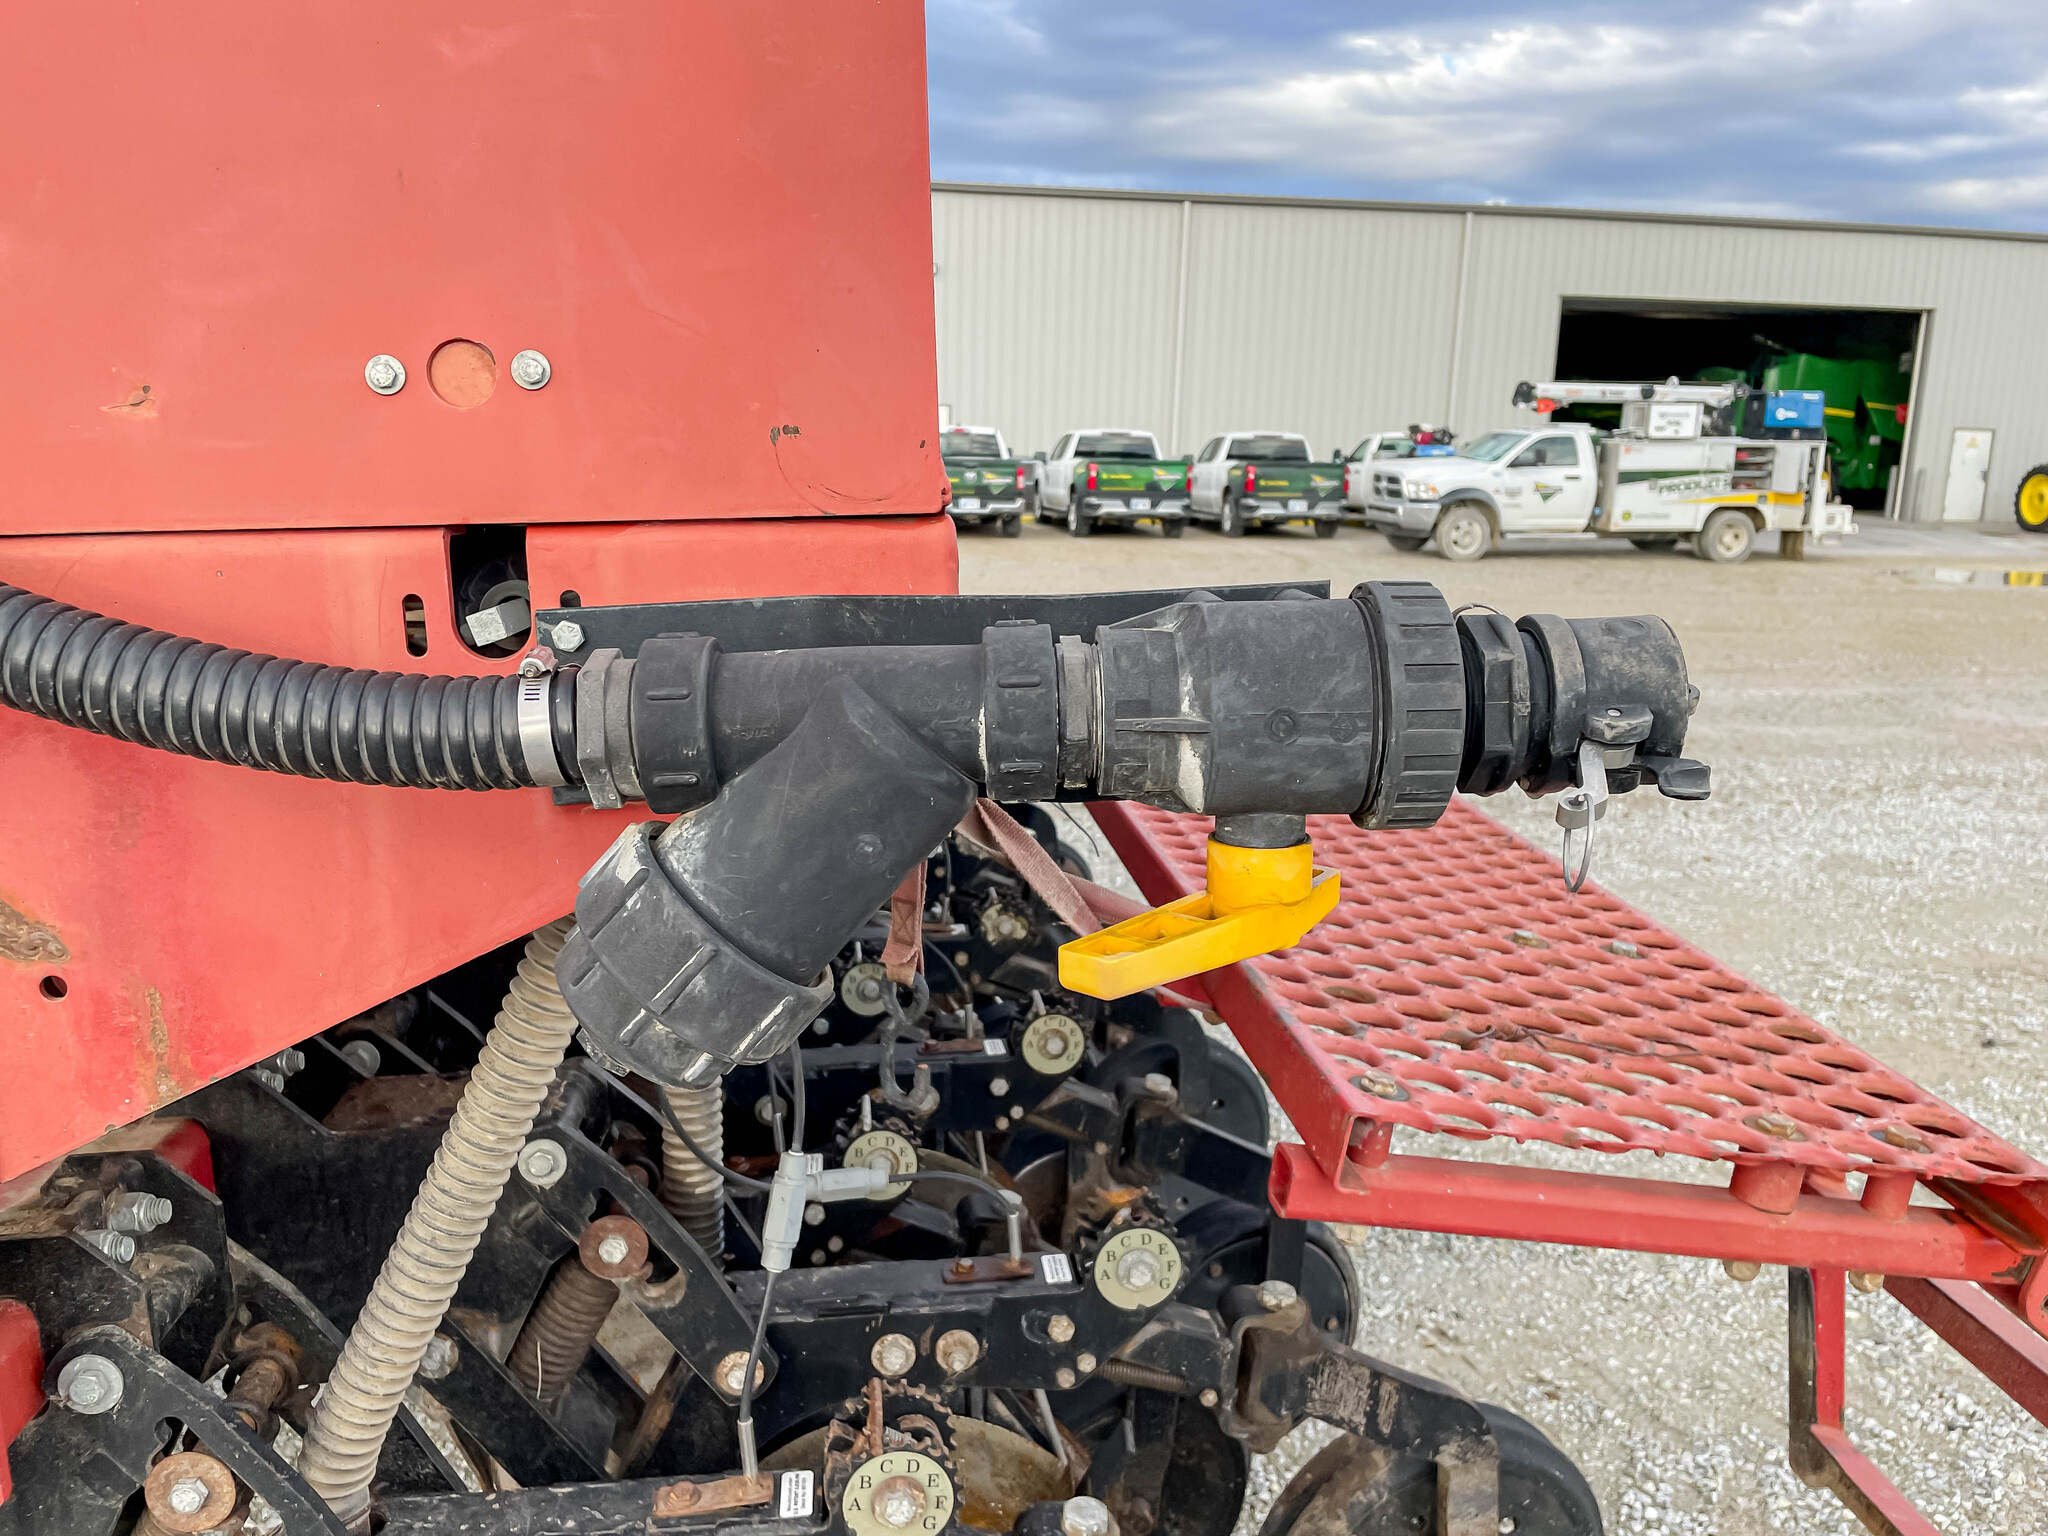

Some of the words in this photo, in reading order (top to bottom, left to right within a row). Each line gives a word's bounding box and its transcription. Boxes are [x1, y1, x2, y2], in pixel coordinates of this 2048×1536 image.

[854, 1147, 864, 1158] B
[868, 1136, 878, 1146] C
[886, 1136, 896, 1146] D
[900, 1147, 909, 1157] E
[905, 1162, 914, 1172] F
[1121, 1236, 1131, 1248] C
[1140, 1233, 1152, 1245] D
[1158, 1243, 1168, 1255] E
[1106, 1250, 1116, 1262] B
[1167, 1260, 1176, 1272] F
[1100, 1269, 1111, 1280] A
[1159, 1278, 1170, 1289] G
[880, 1460, 893, 1473] C
[906, 1459, 920, 1473] D
[860, 1475, 872, 1489] B
[927, 1473, 940, 1487] E
[848, 1498, 862, 1510] A
[935, 1495, 947, 1509] F
[923, 1516, 936, 1530] G
